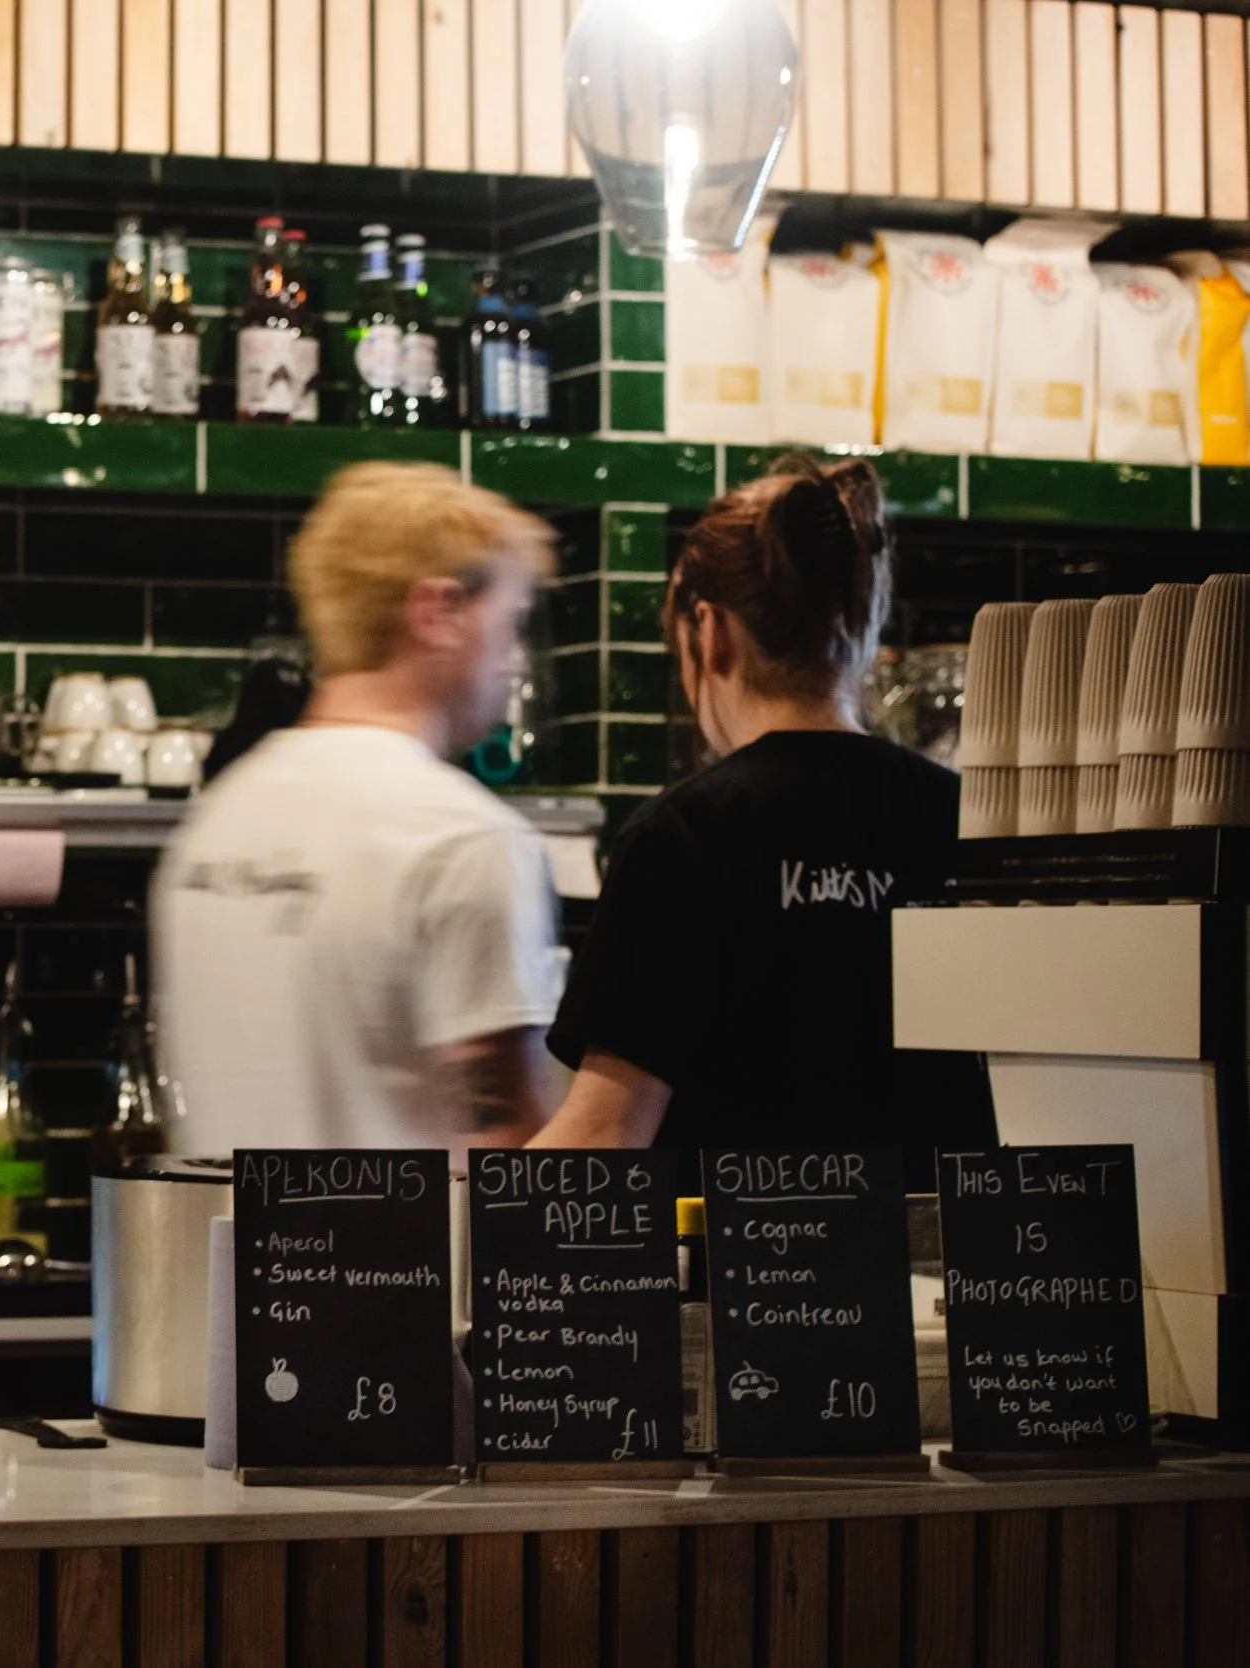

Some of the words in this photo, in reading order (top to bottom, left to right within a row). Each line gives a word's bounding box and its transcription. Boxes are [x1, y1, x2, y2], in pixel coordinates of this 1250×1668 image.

[479, 1154, 610, 1197] SPICED
[716, 1153, 869, 1193] SIDECAR
[545, 1202, 652, 1242] APPLE
[269, 1230, 333, 1256] Aperol
[744, 1220, 828, 1255] Cognac
[1015, 1222, 1048, 1253] IS
[268, 1264, 336, 1284] Sweet
[497, 1268, 553, 1298] Apple
[560, 1274, 575, 1295] &
[580, 1274, 677, 1292] Cinnamon
[746, 1266, 816, 1285] Lemon
[947, 1269, 1138, 1310] PHOTOGRAPHED
[270, 1301, 311, 1323] Gin
[746, 1302, 862, 1326] Cointreau
[497, 1325, 550, 1348] Pear
[561, 1326, 638, 1363] Brandy
[965, 1346, 993, 1367] Let
[1003, 1352, 1030, 1367] us
[1037, 1346, 1088, 1366] know
[1096, 1346, 1114, 1367] if
[498, 1359, 574, 1381] Lemon
[348, 1376, 397, 1420] £8
[821, 1378, 876, 1419] £10
[969, 1376, 1001, 1399] you
[1008, 1374, 1056, 1391] don't
[1066, 1377, 1117, 1390] want
[500, 1393, 559, 1428] Honey
[564, 1394, 619, 1420] Syrup
[999, 1398, 1021, 1413] to
[1029, 1398, 1053, 1413] be
[497, 1434, 553, 1450] Cider
[612, 1408, 659, 1460] £11
